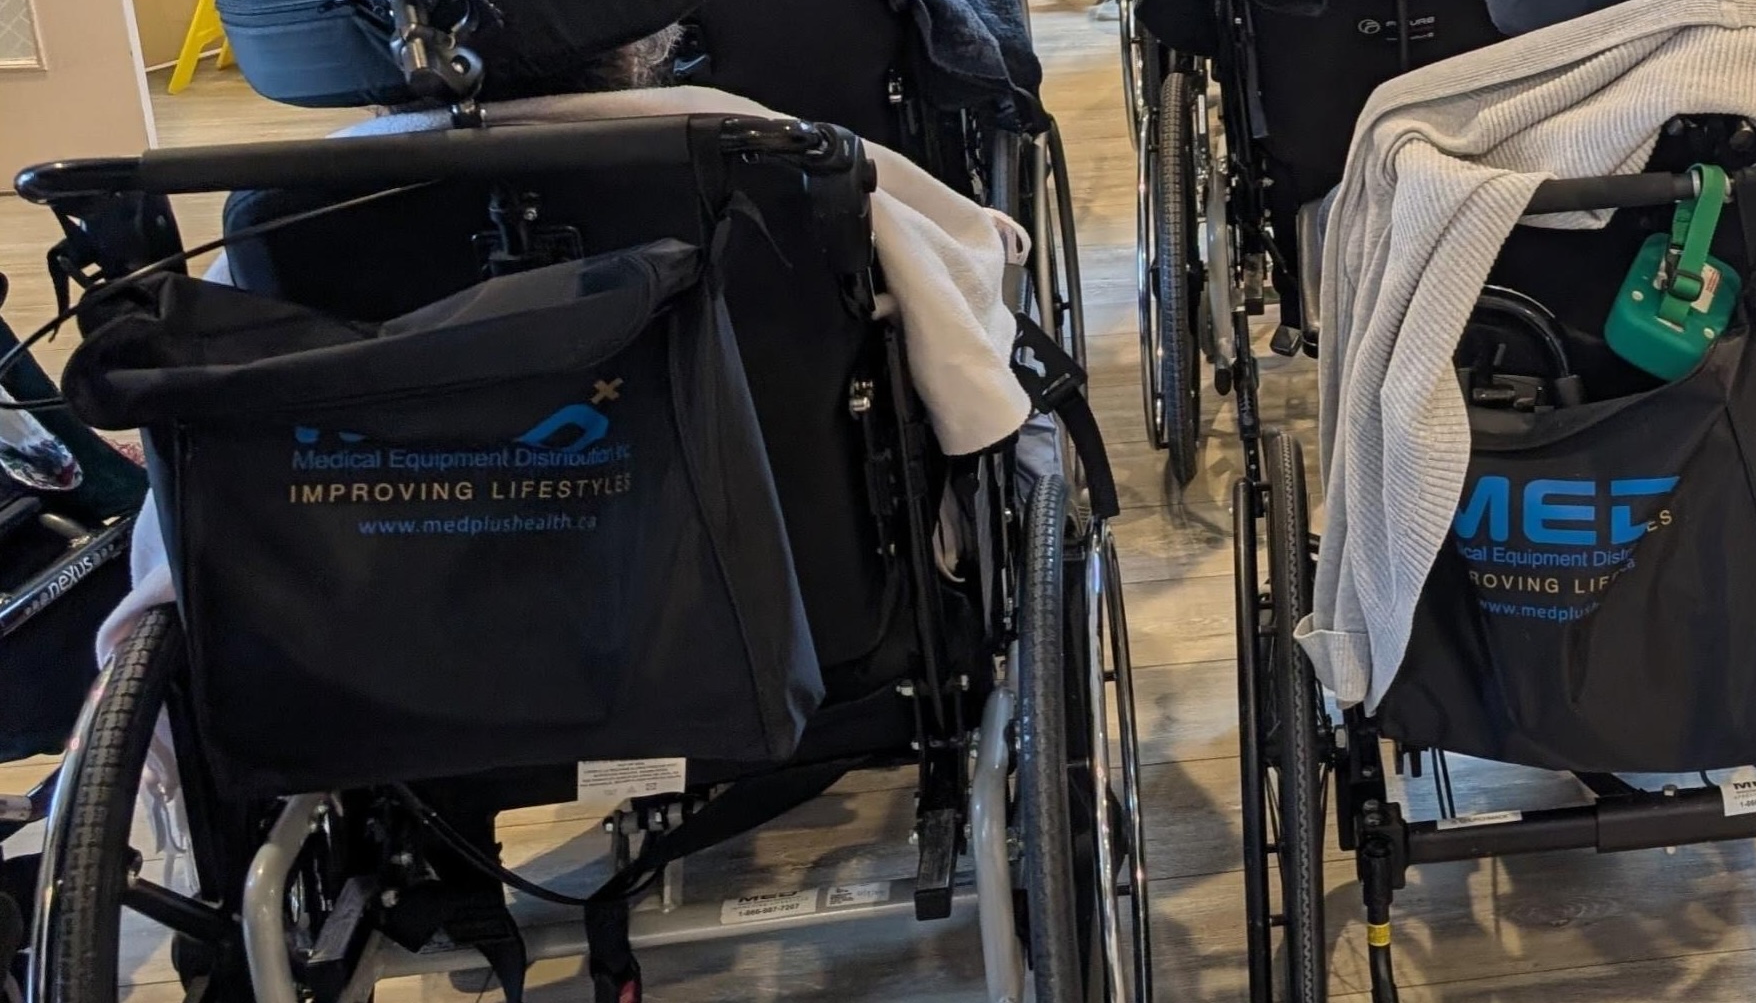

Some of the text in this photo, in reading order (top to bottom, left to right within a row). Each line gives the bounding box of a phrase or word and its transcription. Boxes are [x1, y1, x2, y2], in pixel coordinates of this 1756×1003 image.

[292, 450, 381, 470] Medical
[388, 448, 508, 472] Equipment
[289, 473, 632, 503] IMPROVING LIFESTYLES
[358, 513, 597, 536] www.medplushealth.ca
[1493, 548, 1588, 568] Equipment
